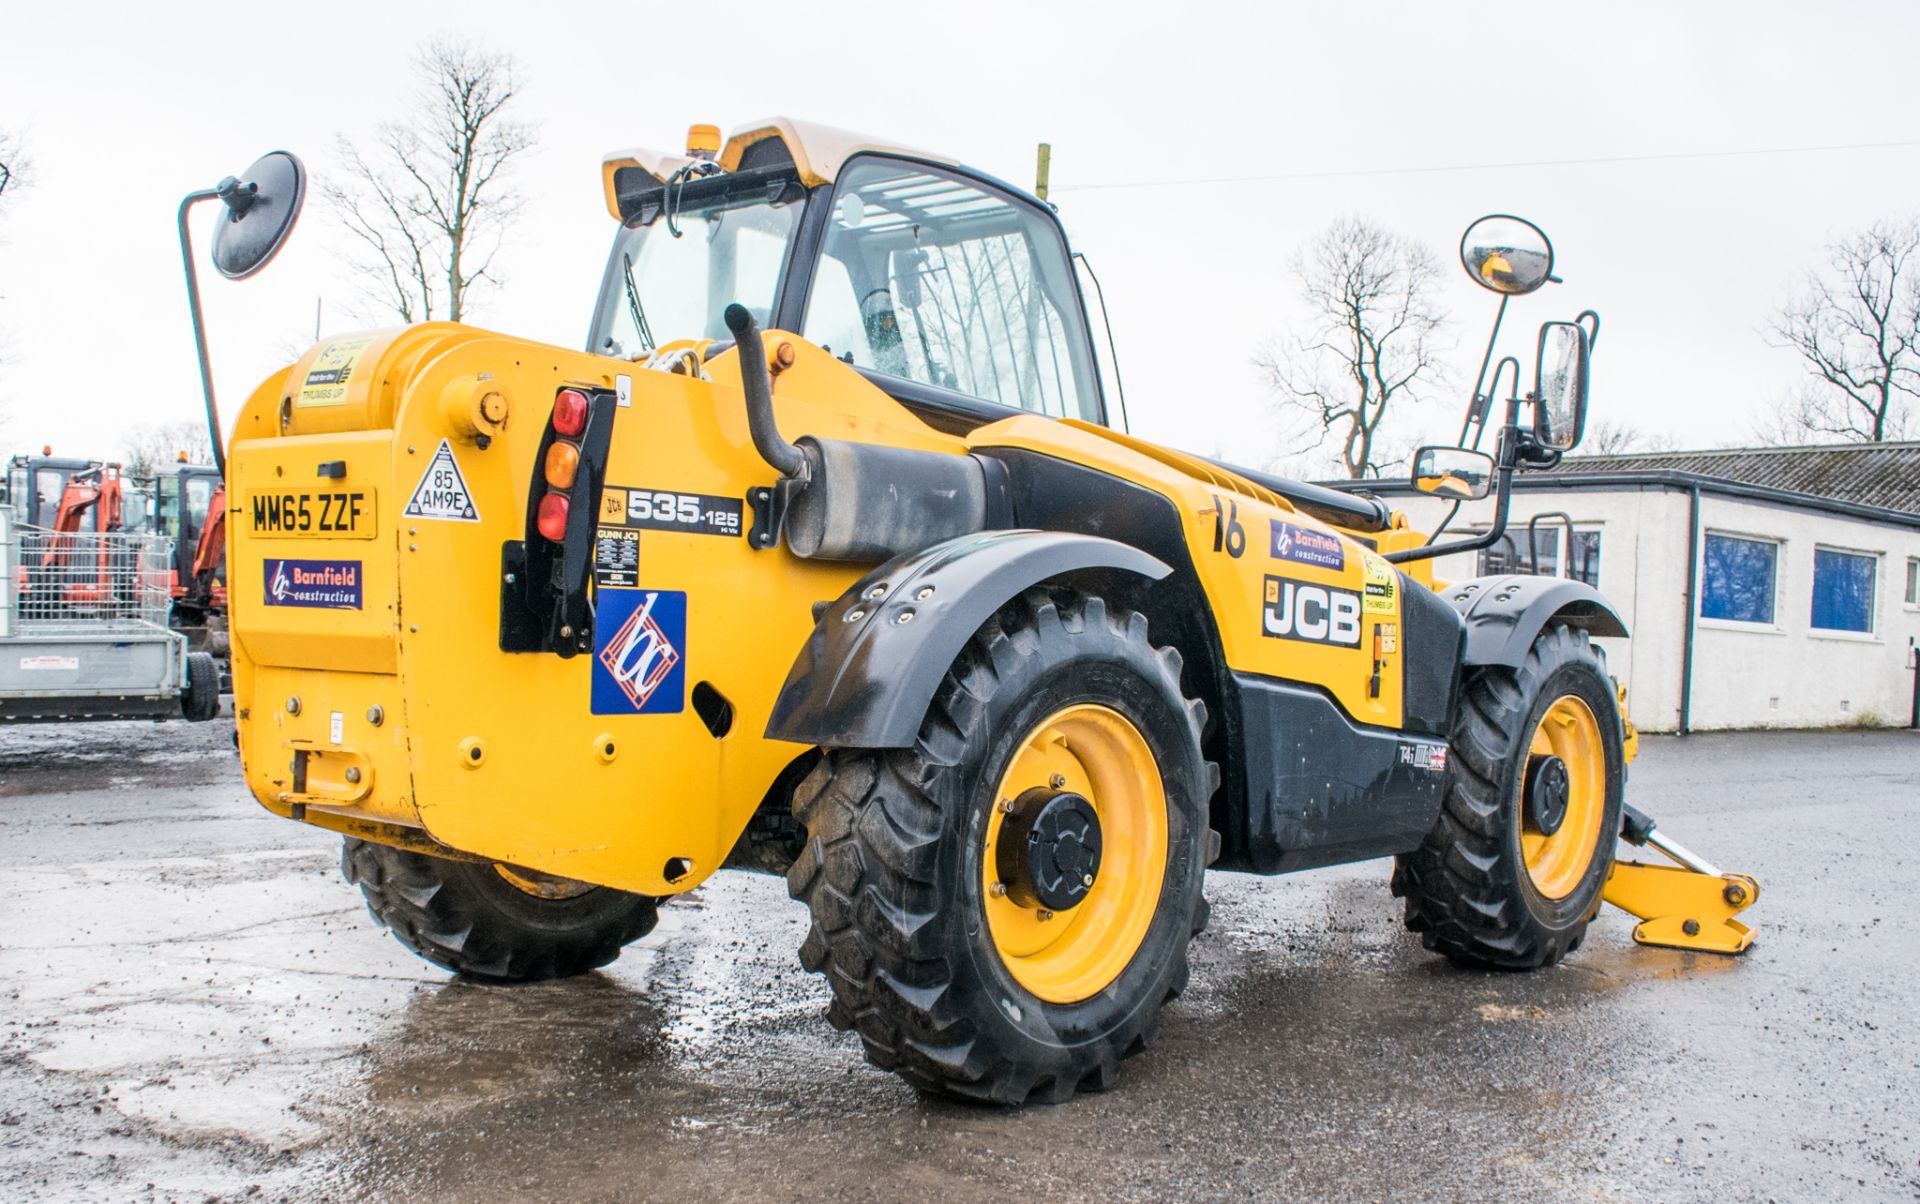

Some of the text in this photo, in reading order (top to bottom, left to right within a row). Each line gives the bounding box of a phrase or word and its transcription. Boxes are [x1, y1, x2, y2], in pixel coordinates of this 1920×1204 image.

[434, 470, 453, 489] 85
[422, 489, 463, 510] AM9E
[606, 498, 622, 513] JCB
[253, 493, 364, 531] MM65 ZZF
[597, 529, 639, 541] GUNN JCB
[1213, 494, 1246, 559] 16
[1295, 530, 1340, 553] Barnfield
[1295, 549, 1340, 566] construction
[293, 567, 356, 586] Barnfield
[294, 590, 356, 603] construction
[1264, 583, 1361, 644] JCB
